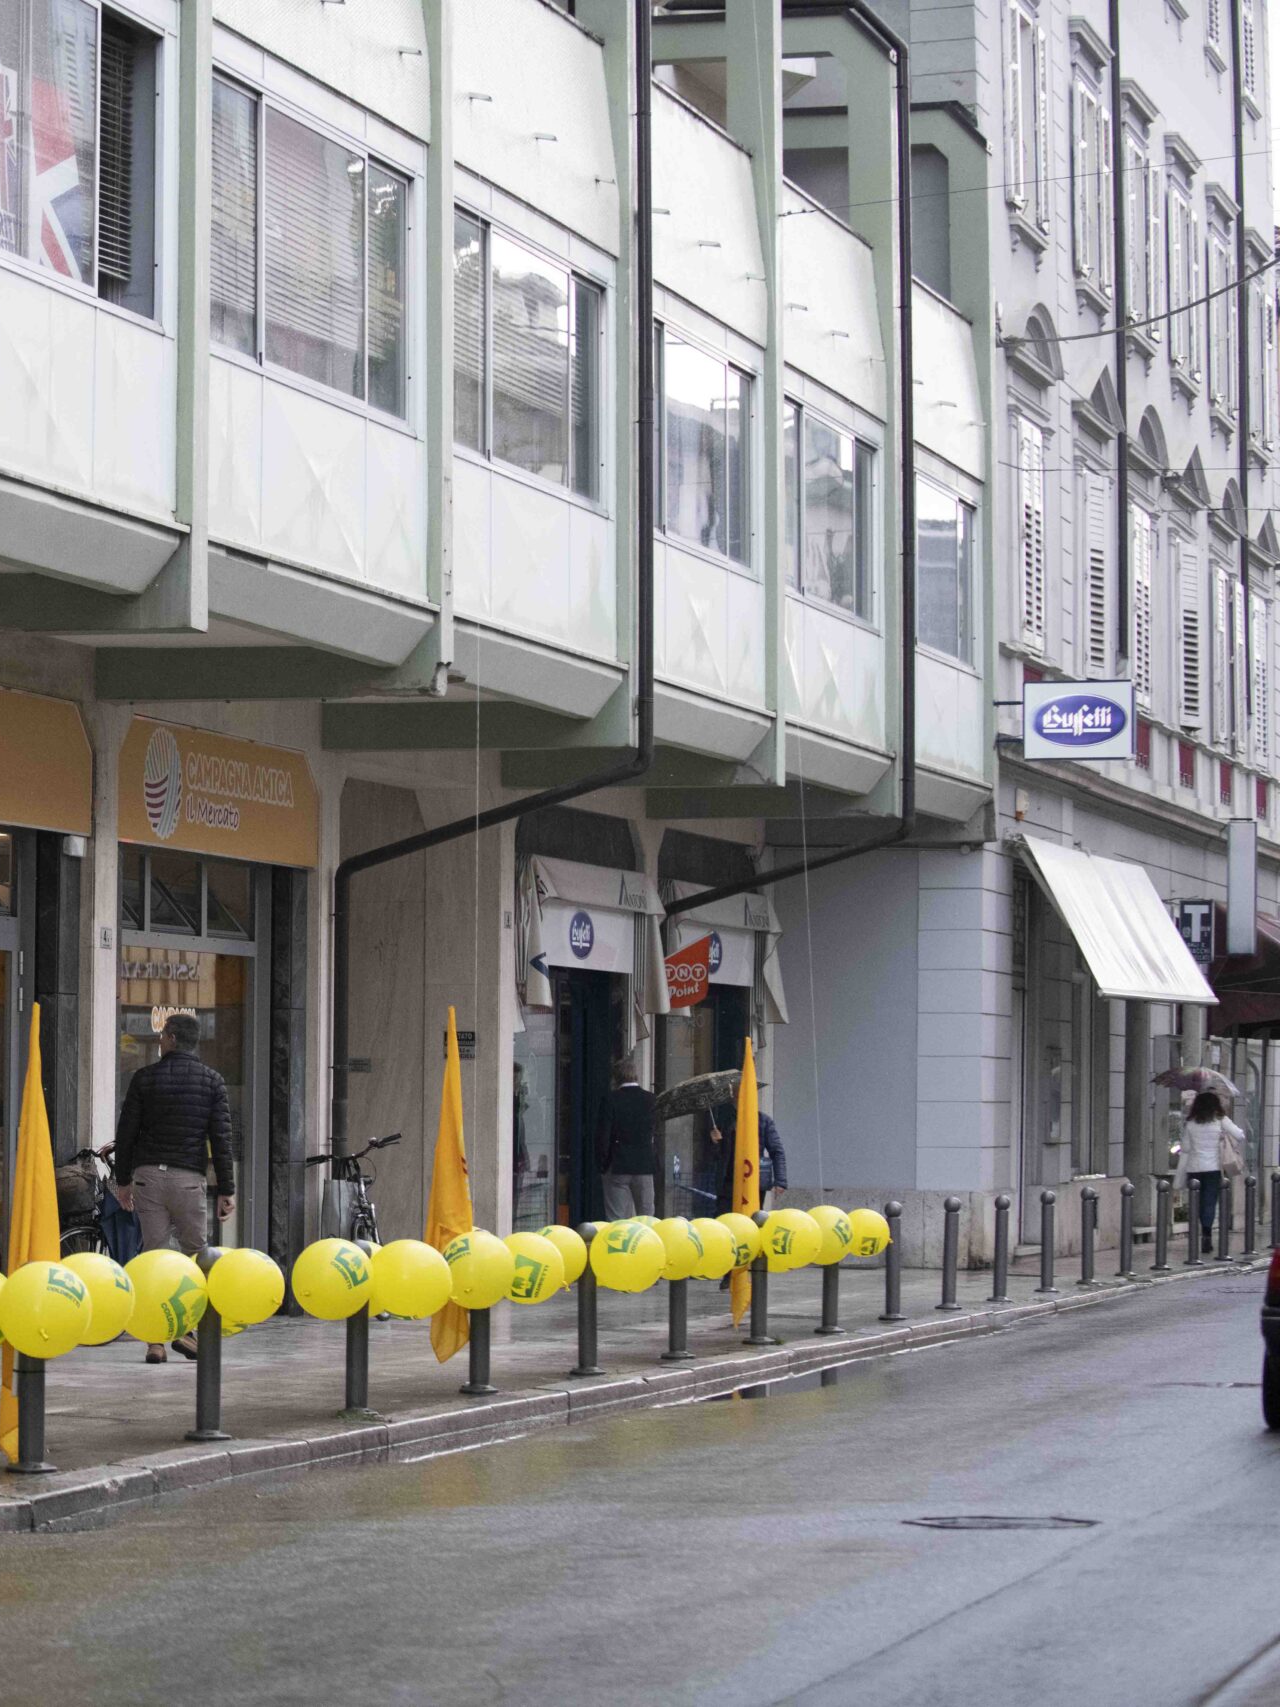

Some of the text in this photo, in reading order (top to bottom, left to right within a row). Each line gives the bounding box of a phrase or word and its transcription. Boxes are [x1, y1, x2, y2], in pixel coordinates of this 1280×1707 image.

[1043, 704, 1112, 737] Buffetti
[186, 752, 294, 808] CAMPAGNA AMICA
[186, 793, 240, 831] Il Mercato
[1184, 905, 1209, 942] T
[665, 966, 705, 979] TNT
[669, 982, 700, 998] Point
